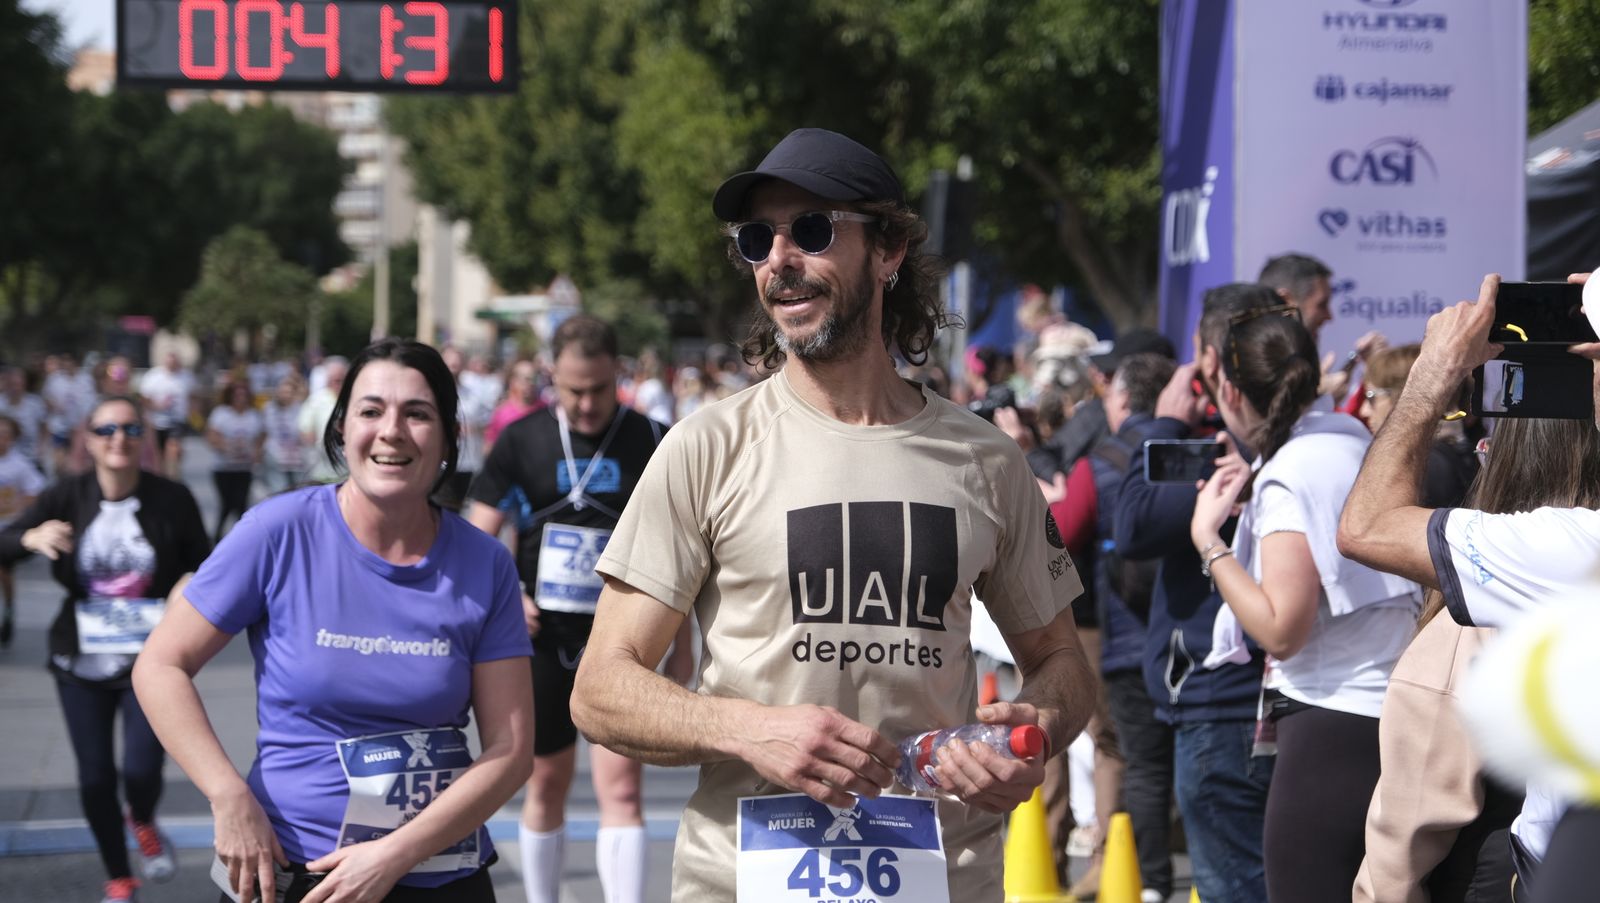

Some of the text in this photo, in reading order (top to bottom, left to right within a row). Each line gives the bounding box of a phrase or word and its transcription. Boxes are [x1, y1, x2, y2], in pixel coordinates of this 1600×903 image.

[1323, 11, 1447, 32] HYUNDAI
[1353, 78, 1453, 106] cajamar
[1358, 211, 1447, 237] vithas
[1339, 289, 1443, 323] aqualia
[1050, 567, 1064, 581] DE
[798, 567, 942, 625] UAL
[792, 633, 942, 671] deportes
[363, 750, 402, 764] MUJER
[768, 818, 815, 830] MUJER
[787, 848, 901, 897] 456
